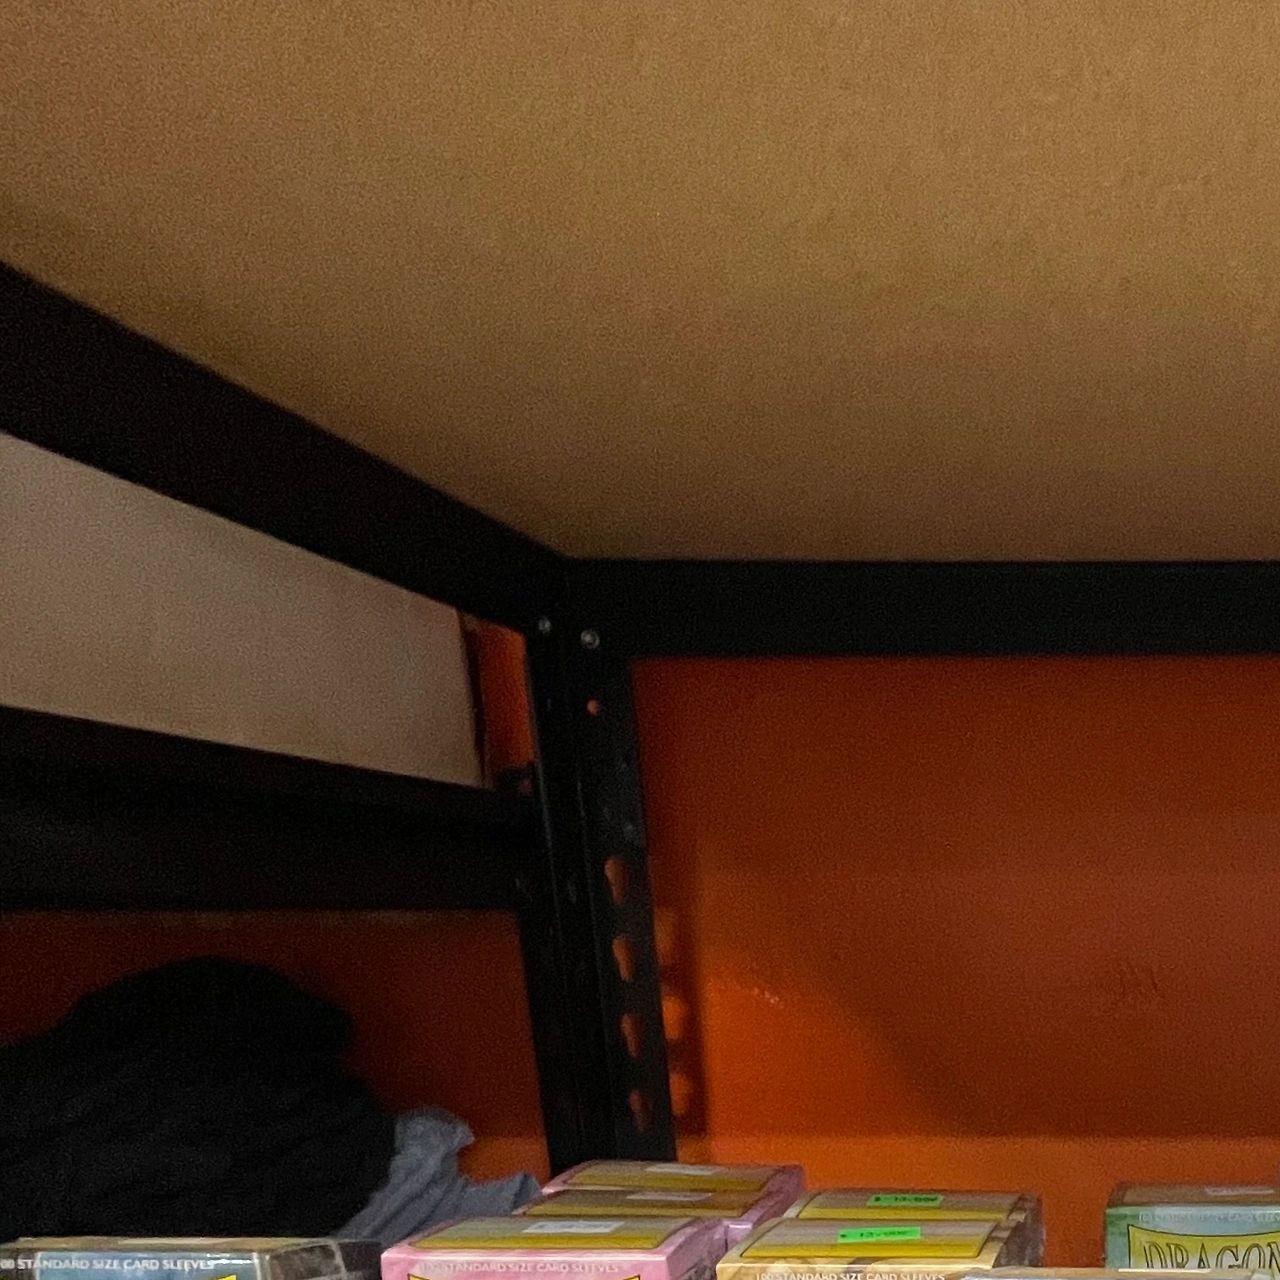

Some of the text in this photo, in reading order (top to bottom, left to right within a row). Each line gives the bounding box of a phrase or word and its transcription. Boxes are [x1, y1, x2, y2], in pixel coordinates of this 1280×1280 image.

[17, 1259, 216, 1271] STANDARD SIZE CARD SLEEVES
